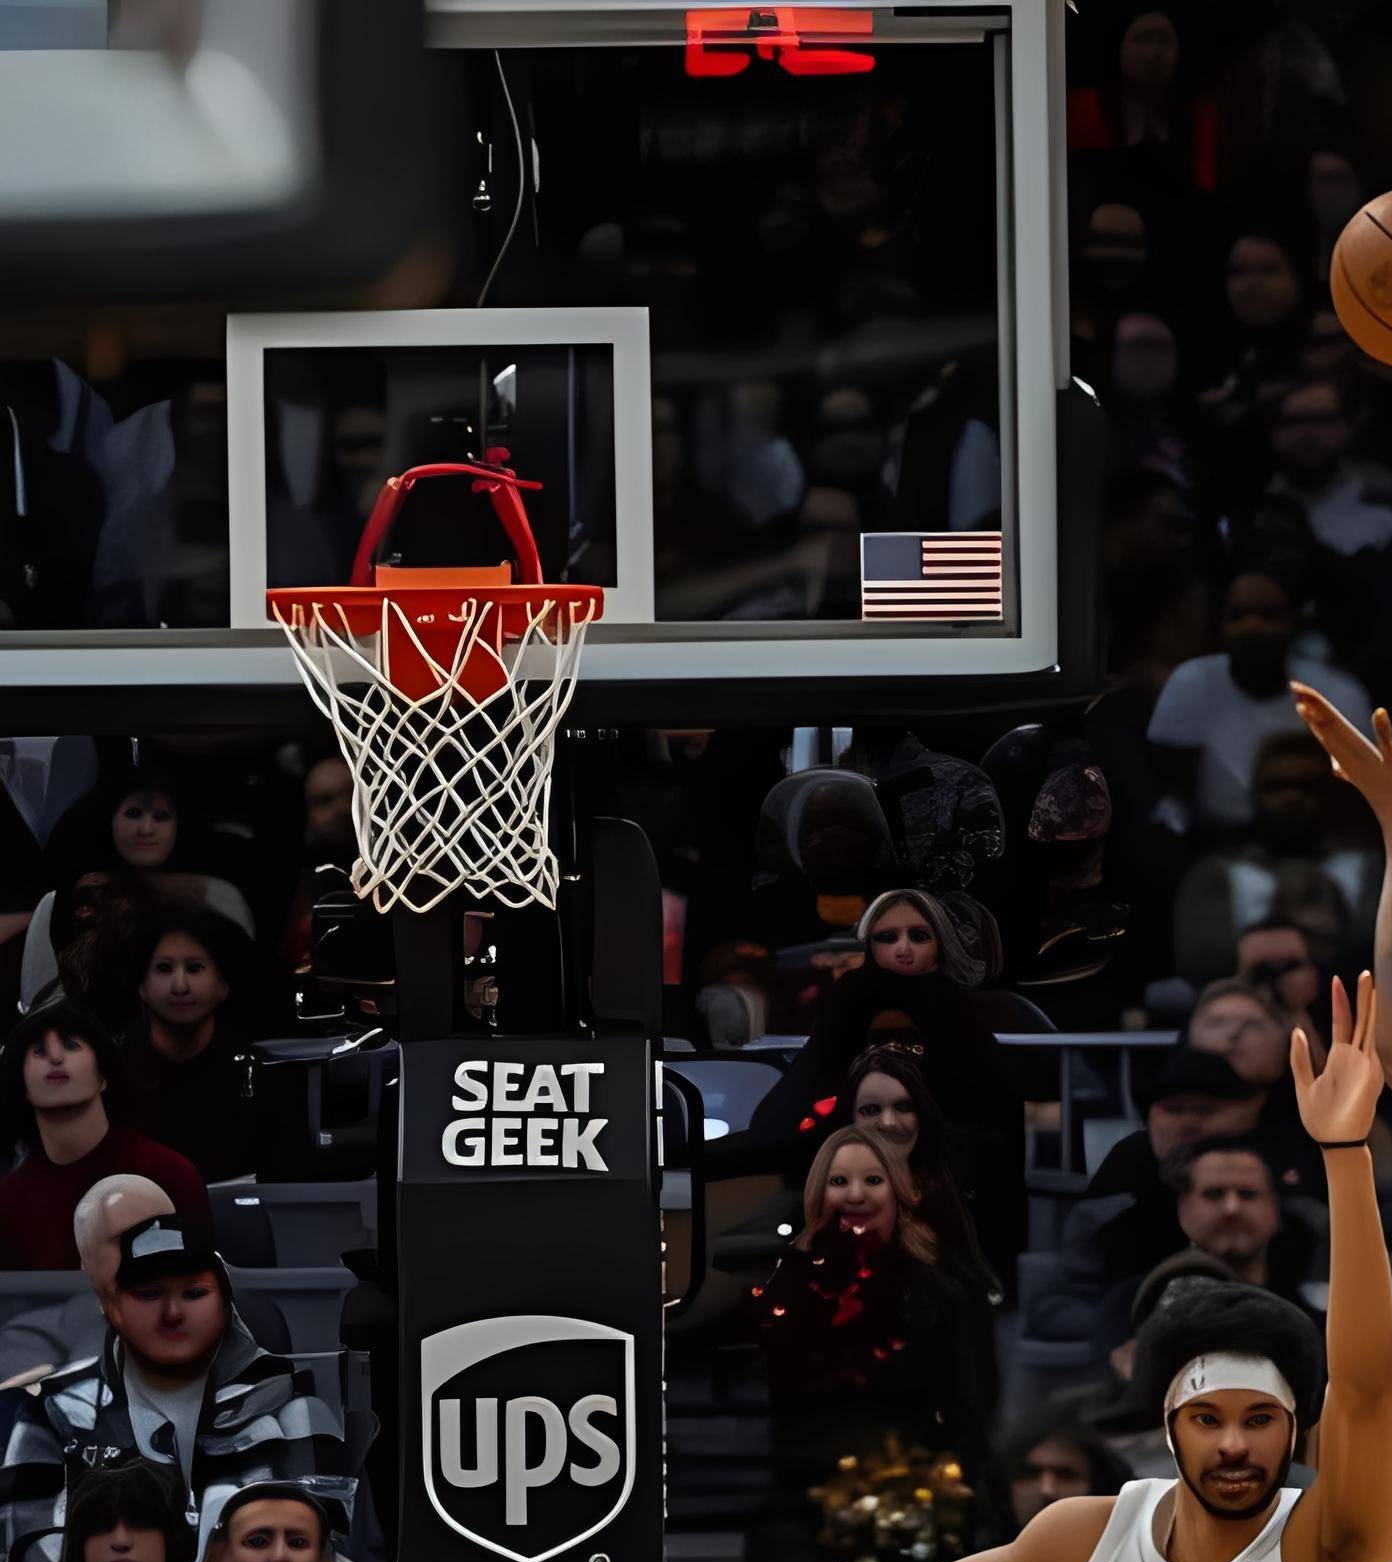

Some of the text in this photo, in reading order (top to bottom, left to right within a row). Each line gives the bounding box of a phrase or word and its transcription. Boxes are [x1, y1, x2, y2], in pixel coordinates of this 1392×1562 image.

[452, 1060, 605, 1113] SEAT
[441, 1117, 610, 1172] GEEK
[439, 1393, 622, 1526] ups
